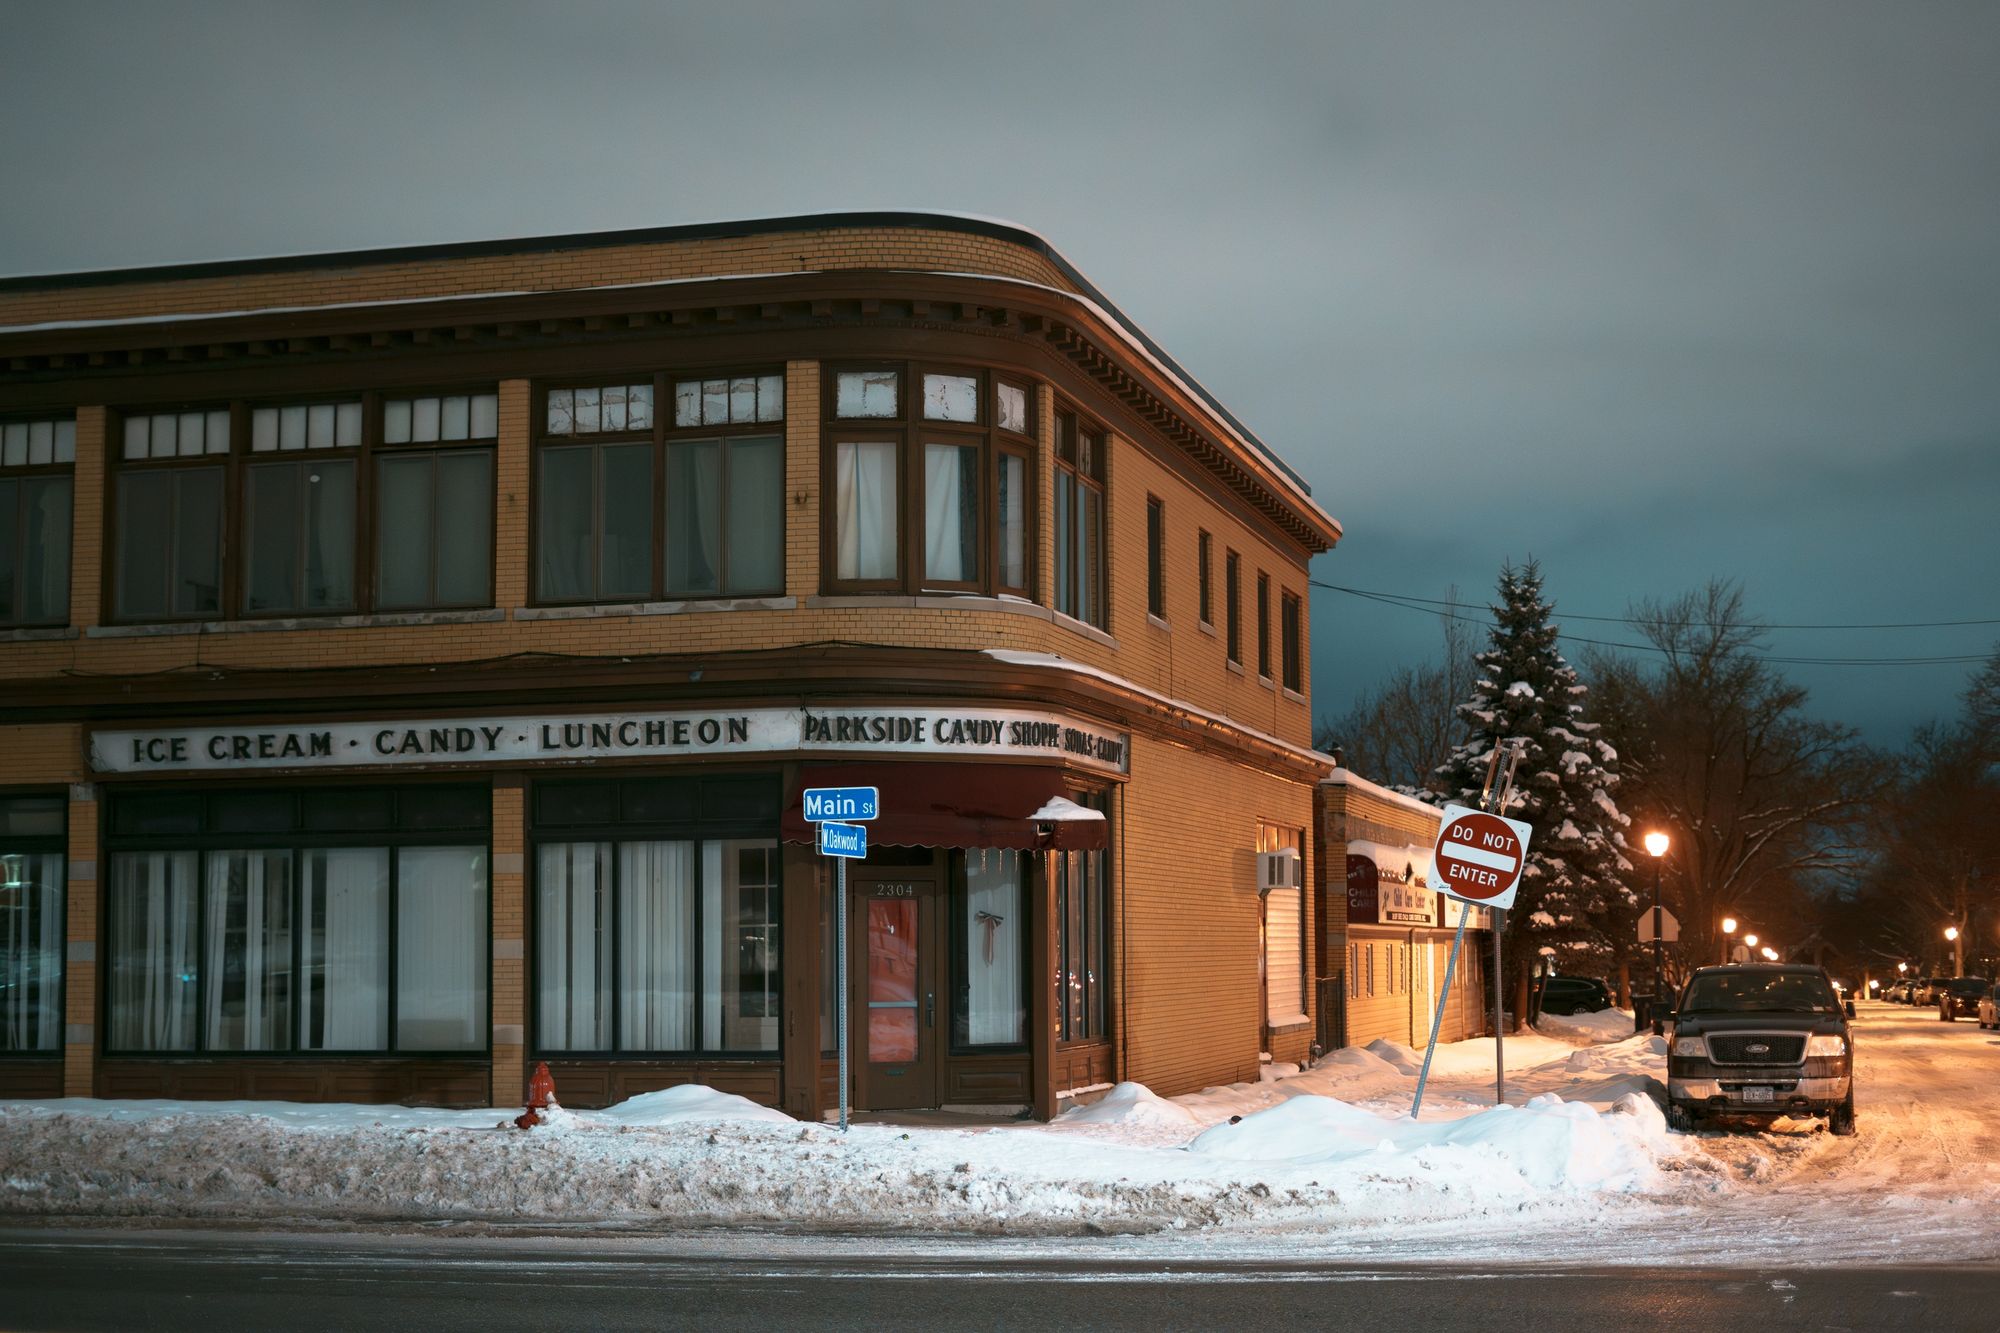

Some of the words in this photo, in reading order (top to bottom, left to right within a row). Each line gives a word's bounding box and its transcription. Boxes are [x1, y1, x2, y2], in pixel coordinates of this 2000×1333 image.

[133, 737, 189, 763] ICE
[208, 731, 332, 761] CREAM
[375, 726, 504, 755] CANDY
[542, 717, 749, 750] LUNCHEON
[804, 715, 927, 743] PARKSIDE
[935, 717, 1005, 745] CANDY
[1011, 720, 1060, 748] SHOPPE
[1065, 728, 1093, 756] SODAS
[806, 794, 856, 815] Main
[862, 802, 873, 814] St
[1452, 825, 1474, 841] DO
[1483, 832, 1515, 851] NOT
[1449, 863, 1498, 888] ENTER
[877, 883, 913, 896] 2304
[1348, 887, 1377, 897] CHILD
